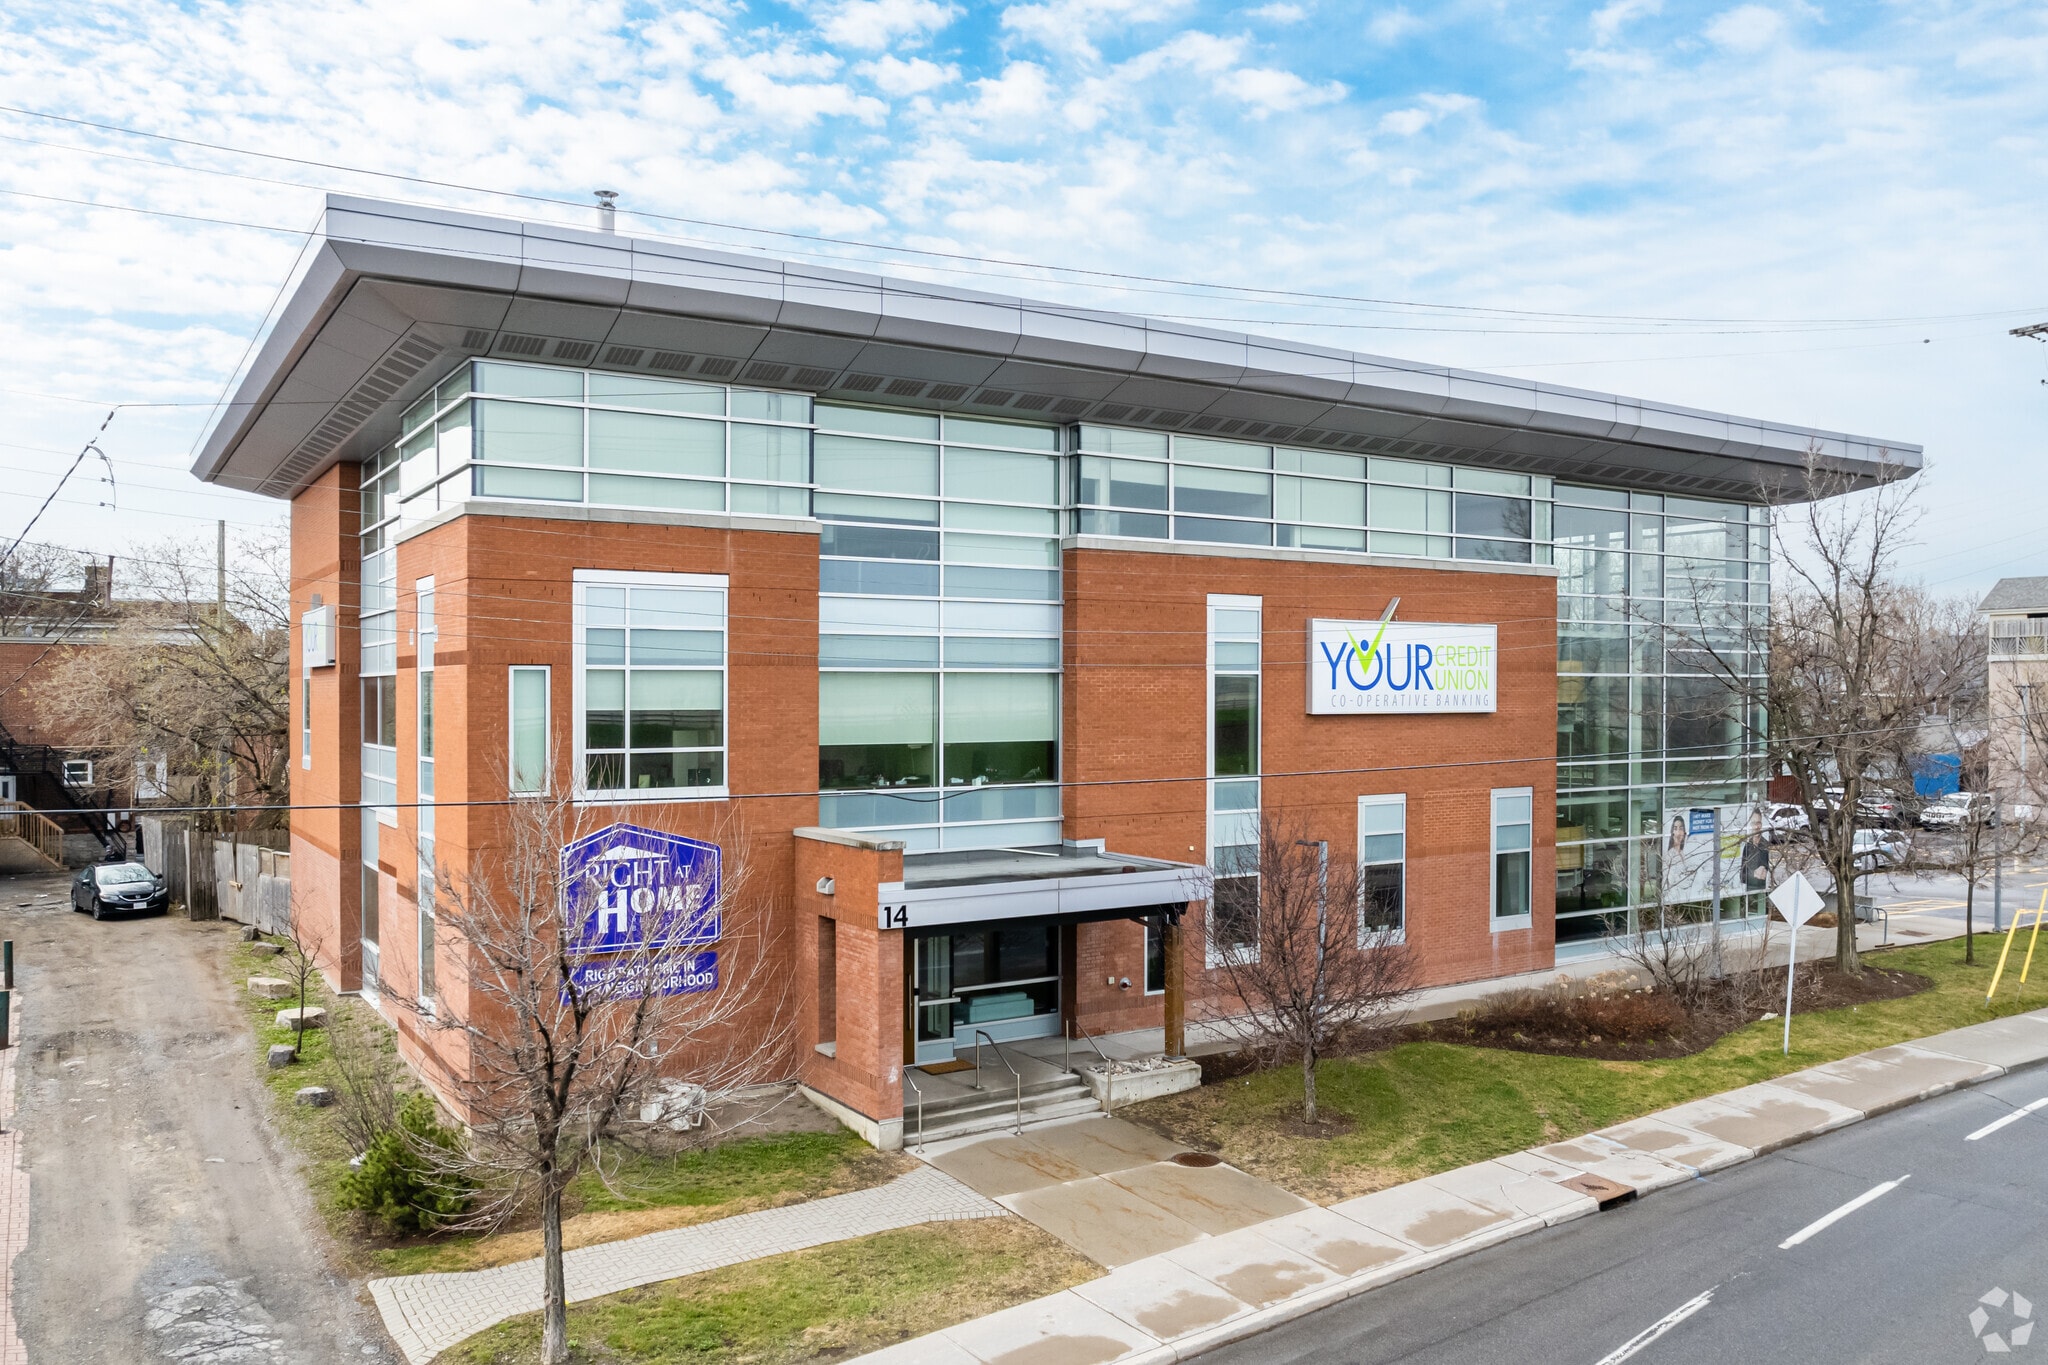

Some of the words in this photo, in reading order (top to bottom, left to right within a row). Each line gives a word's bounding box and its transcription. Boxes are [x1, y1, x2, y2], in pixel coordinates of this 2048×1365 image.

[1320, 640, 1434, 691] YOUR
[1435, 645, 1491, 667] CREDIT
[1435, 669, 1488, 691] UNION
[1331, 694, 1428, 708] CO-OPERATIVE
[1436, 694, 1489, 707] BANKING
[586, 860, 669, 888] RIGHT
[675, 865, 691, 878] AT
[598, 884, 702, 934] HOME
[884, 904, 908, 928] 14
[586, 967, 623, 982] RIGHT
[684, 959, 696, 972] IN
